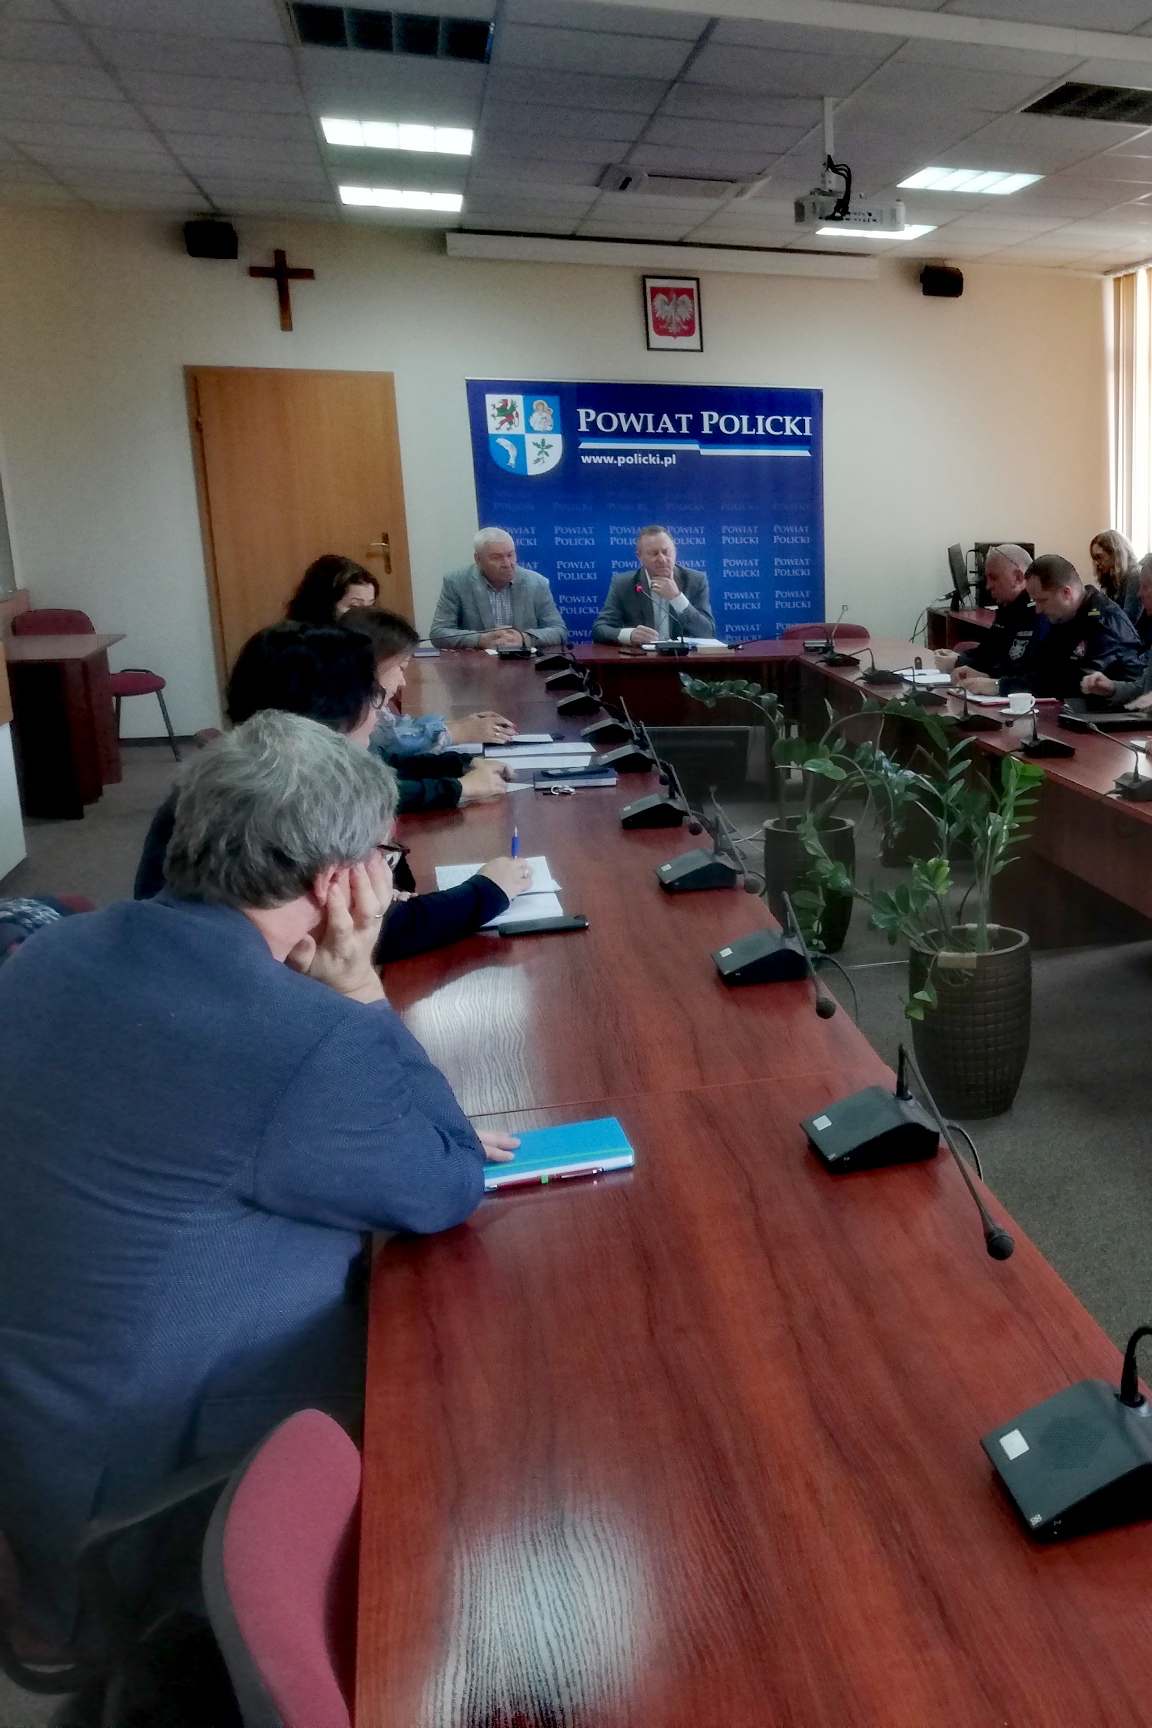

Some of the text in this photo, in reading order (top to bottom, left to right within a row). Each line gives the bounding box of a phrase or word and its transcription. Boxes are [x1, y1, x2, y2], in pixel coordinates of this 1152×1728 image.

[577, 408, 812, 436] POWIAT POLICKI
[581, 453, 676, 467] www.policki.pl
[554, 526, 594, 534] POWIAT
[609, 526, 641, 534] POWIA
[722, 525, 758, 534] POWIAT
[773, 525, 810, 533] POWIAT
[514, 538, 538, 546] ICKI
[555, 538, 595, 546] POLICKI
[610, 537, 637, 545] POLIC
[672, 537, 706, 546] OLICKI
[722, 536, 759, 545] POLICKI
[773, 536, 810, 544] POLICKI
[557, 561, 596, 569] POWIAT
[611, 560, 643, 569] POWIA
[722, 558, 760, 567] POWIAT
[774, 558, 810, 566] POWIAT
[558, 572, 597, 580] POLICKI
[723, 570, 760, 578] POLICKI
[774, 569, 811, 577] POLICKI
[723, 592, 760, 600] POWIAT
[774, 590, 811, 598] POWIAT
[559, 595, 598, 603] POWIAT
[724, 602, 761, 611] POLICKI
[775, 601, 811, 609] POLICKI
[560, 606, 599, 615] POLICKI
[725, 624, 762, 633] POWIAT
